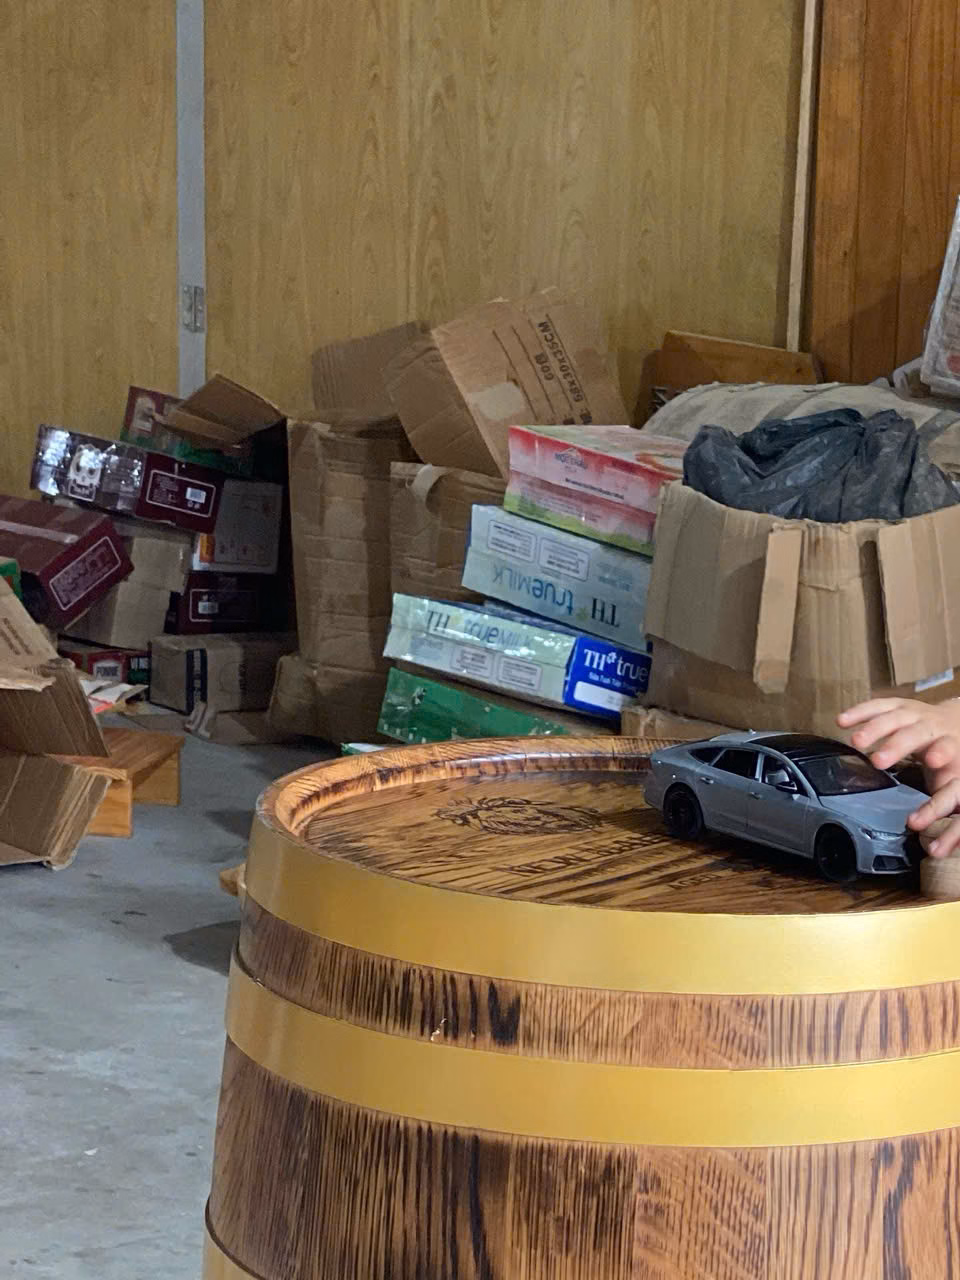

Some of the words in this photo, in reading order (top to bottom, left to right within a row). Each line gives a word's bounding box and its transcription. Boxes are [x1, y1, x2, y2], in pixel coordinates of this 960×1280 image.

[426, 610, 451, 635] TH
[591, 597, 620, 628] TH
[584, 648, 607, 671] TH
[616, 656, 649, 682] true
